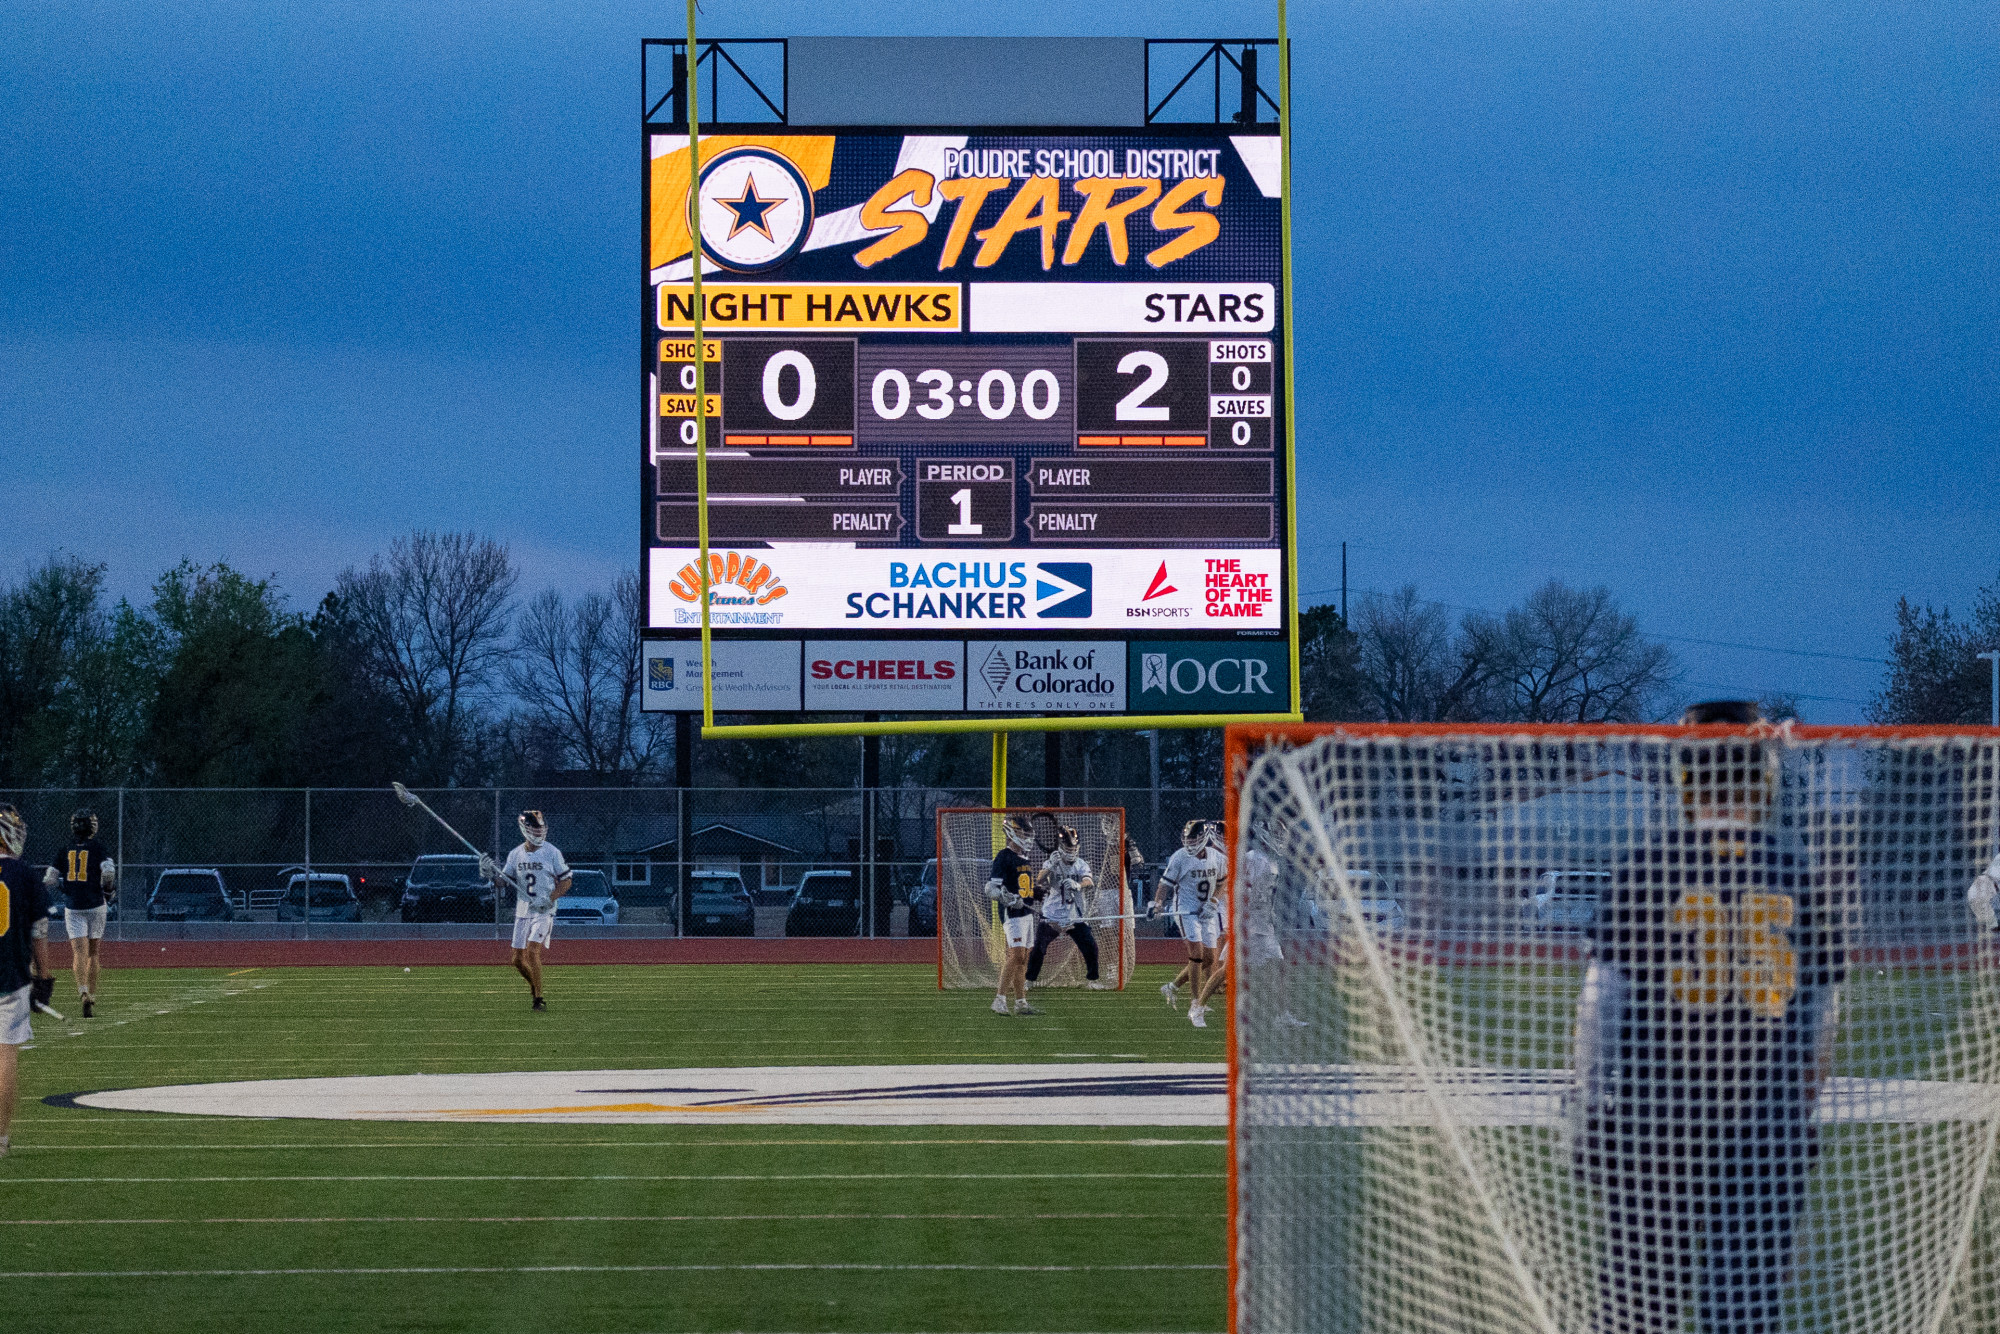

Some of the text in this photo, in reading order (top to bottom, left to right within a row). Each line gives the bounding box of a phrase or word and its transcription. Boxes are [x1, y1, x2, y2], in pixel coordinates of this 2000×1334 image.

[944, 149, 1221, 178] POUDRE SCHOOL DISTRICT
[853, 168, 1226, 271] STARS
[667, 293, 952, 322] NIGHT HAWKS
[1144, 293, 1264, 323] STARS
[666, 344, 715, 358] SHOS
[1216, 345, 1266, 359] SHOTS
[680, 365, 698, 390] 0
[762, 350, 816, 420] 0
[1116, 350, 1170, 421] 2
[1232, 366, 1251, 391] 0
[871, 369, 1060, 420] 03:00
[667, 399, 714, 413] SAVS
[1217, 401, 1265, 415] SAVES
[680, 420, 699, 445] 0
[1231, 421, 1251, 446] 0
[840, 469, 891, 486] PLAYER
[927, 465, 1004, 480] PERIOD
[1039, 469, 1091, 486] PLAYER
[948, 489, 982, 535] 1
[833, 513, 892, 531] PENALTY
[1039, 513, 1098, 531] PENALTY
[890, 562, 1027, 588] BACHUS
[1205, 559, 1241, 573] THE
[1205, 574, 1268, 588] HEART
[1205, 588, 1273, 602] OF THE
[845, 592, 1027, 619] SCHANKER
[1126, 608, 1150, 617] BSN
[1205, 603, 1263, 617] GAME
[674, 608, 783, 624] ENTRTAINMENT
[685, 659, 717, 668] Weh
[1015, 649, 1096, 670] Bank of
[685, 670, 744, 680] Magement
[810, 660, 956, 680] SCHEELS
[1169, 658, 1274, 695] OCR
[651, 681, 673, 689] RBC
[686, 683, 724, 692] Greck
[755, 684, 791, 692] Advisors
[1015, 673, 1115, 693] Colorado
[67, 850, 89, 881] 11
[517, 862, 544, 872] STARS
[1191, 868, 1216, 879] STARS
[525, 873, 537, 896] 2
[1197, 880, 1211, 902] 9
